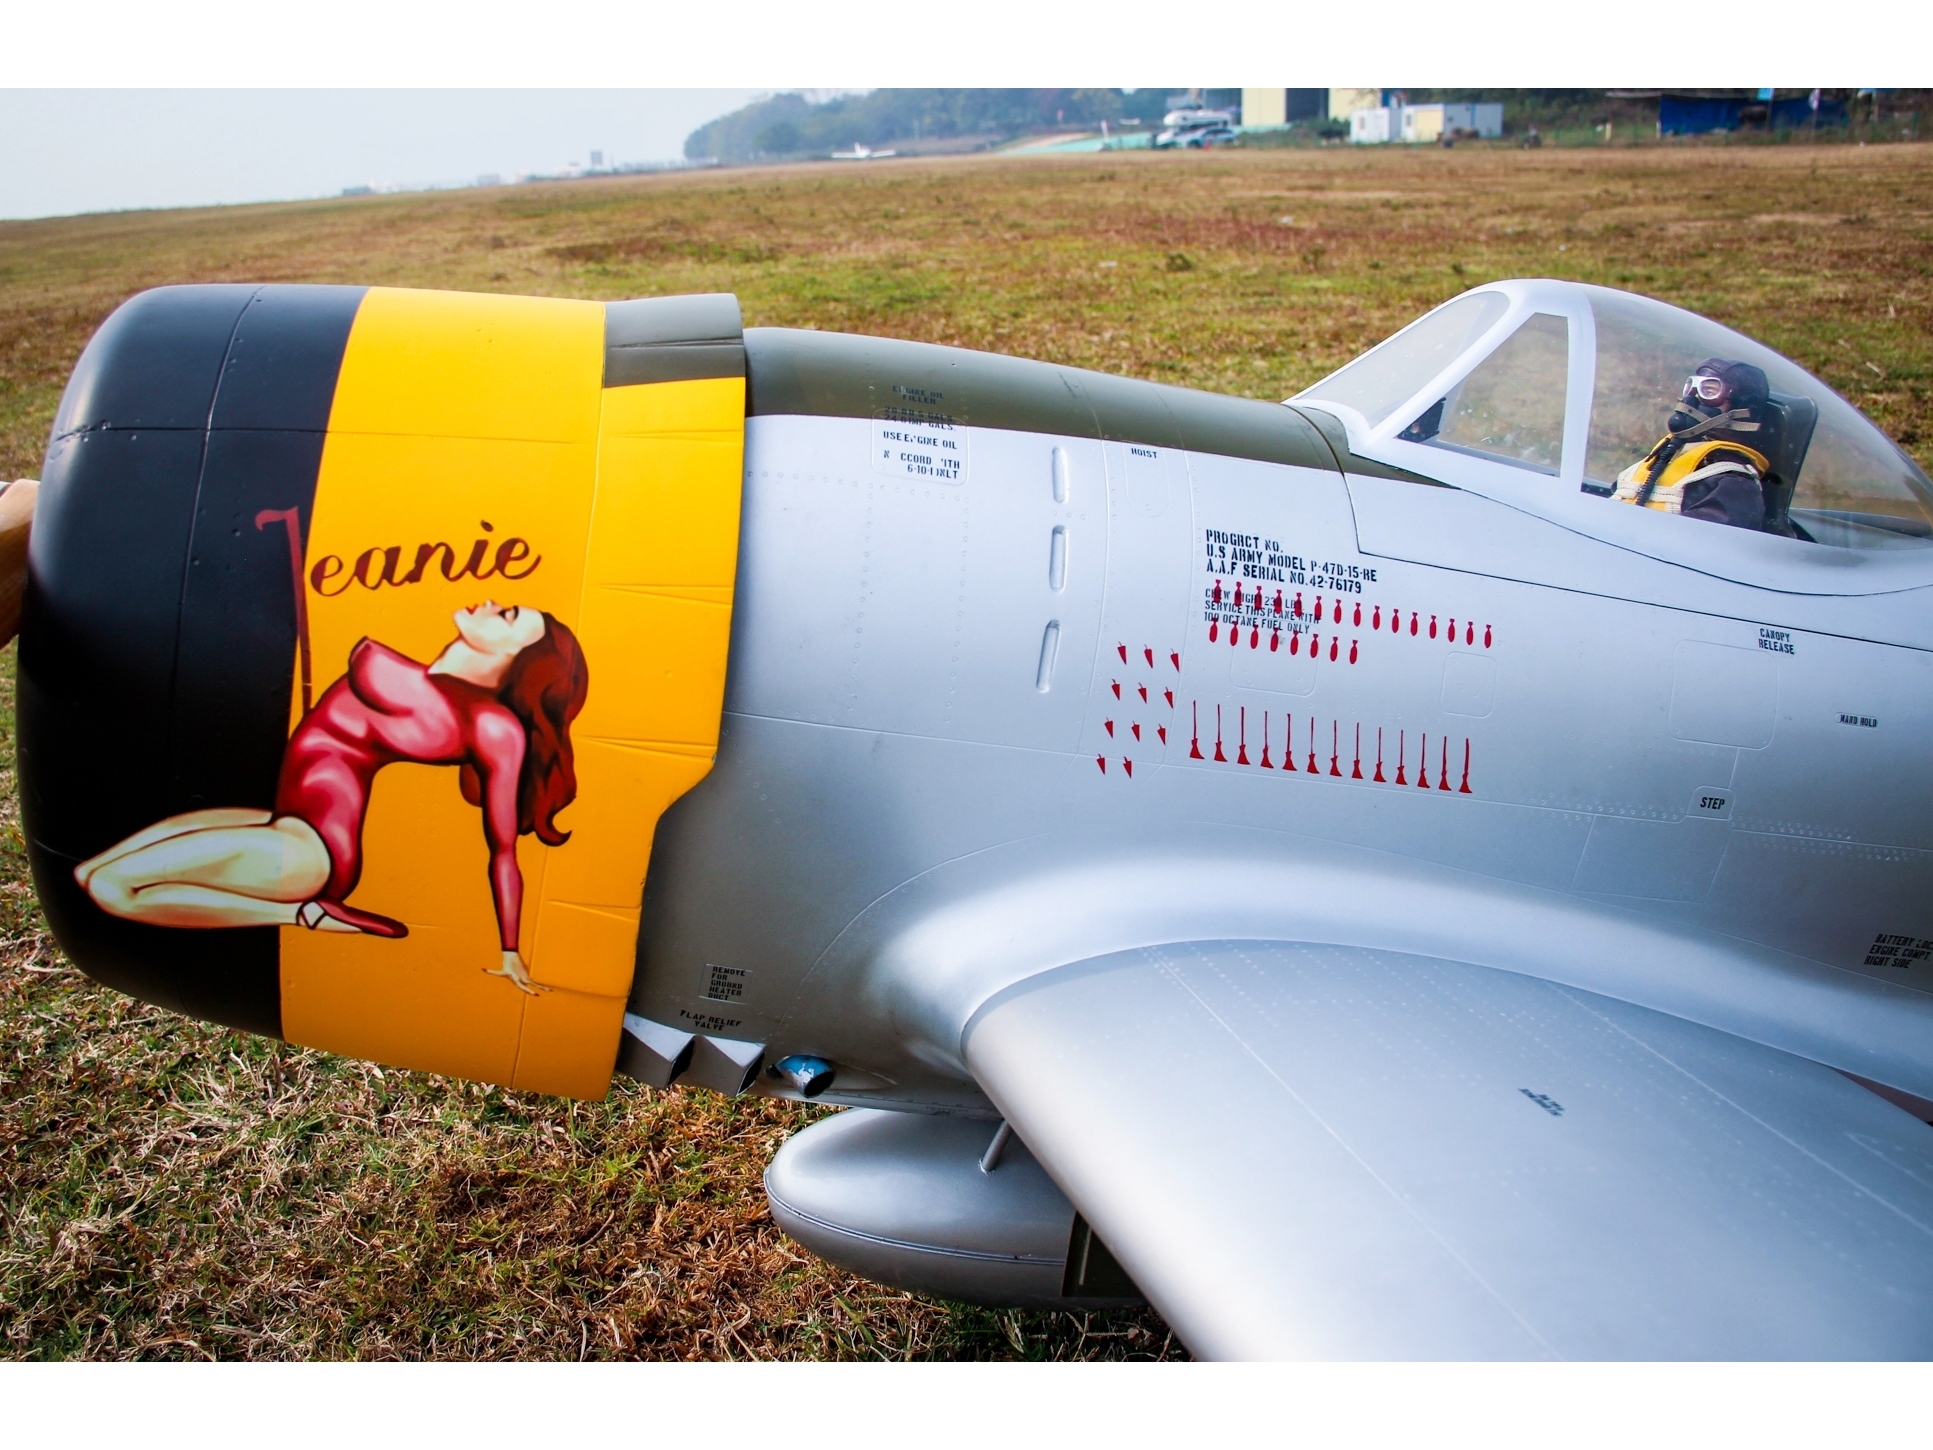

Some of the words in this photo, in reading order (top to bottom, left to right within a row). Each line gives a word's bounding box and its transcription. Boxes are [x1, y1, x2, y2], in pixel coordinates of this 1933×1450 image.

[903, 394, 936, 404] FILLER
[884, 431, 902, 441] USE
[942, 440, 957, 449] OIL
[1130, 448, 1157, 459] HOIST
[941, 458, 960, 469] ITH
[1265, 539, 1283, 553] NO.
[1206, 544, 1226, 559] U.S
[1231, 547, 1262, 565] ARMY
[1268, 554, 1306, 571] MODEL
[1311, 560, 1377, 582] P-47D-15-RE
[1206, 558, 1237, 575] A.A.F
[1243, 564, 1285, 582] SERIAL
[255, 506, 542, 715] Jeanie
[1205, 601, 1242, 614] SERVICE
[1223, 614, 1258, 627] OCTANE
[1262, 619, 1283, 631] FUEL
[1288, 623, 1310, 634] ONLY
[1759, 628, 1790, 642] CANOPY
[1758, 639, 1794, 655] RELEASE
[1860, 717, 1877, 727] HOLD
[1700, 797, 1725, 809] STEP
[1875, 934, 1915, 946] BATTERY
[1916, 939, 1933, 950] LOC
[1869, 944, 1901, 956] ENGINE
[1864, 955, 1890, 966] RIGHT
[1892, 958, 1912, 968] SIDE
[713, 966, 745, 976] REMOVE
[709, 986, 742, 996] HEATER
[711, 980, 742, 989] GROUND
[680, 1010, 705, 1020] FLAP
[708, 1016, 742, 1026] RELIEF
[694, 1020, 724, 1031] VALVE
